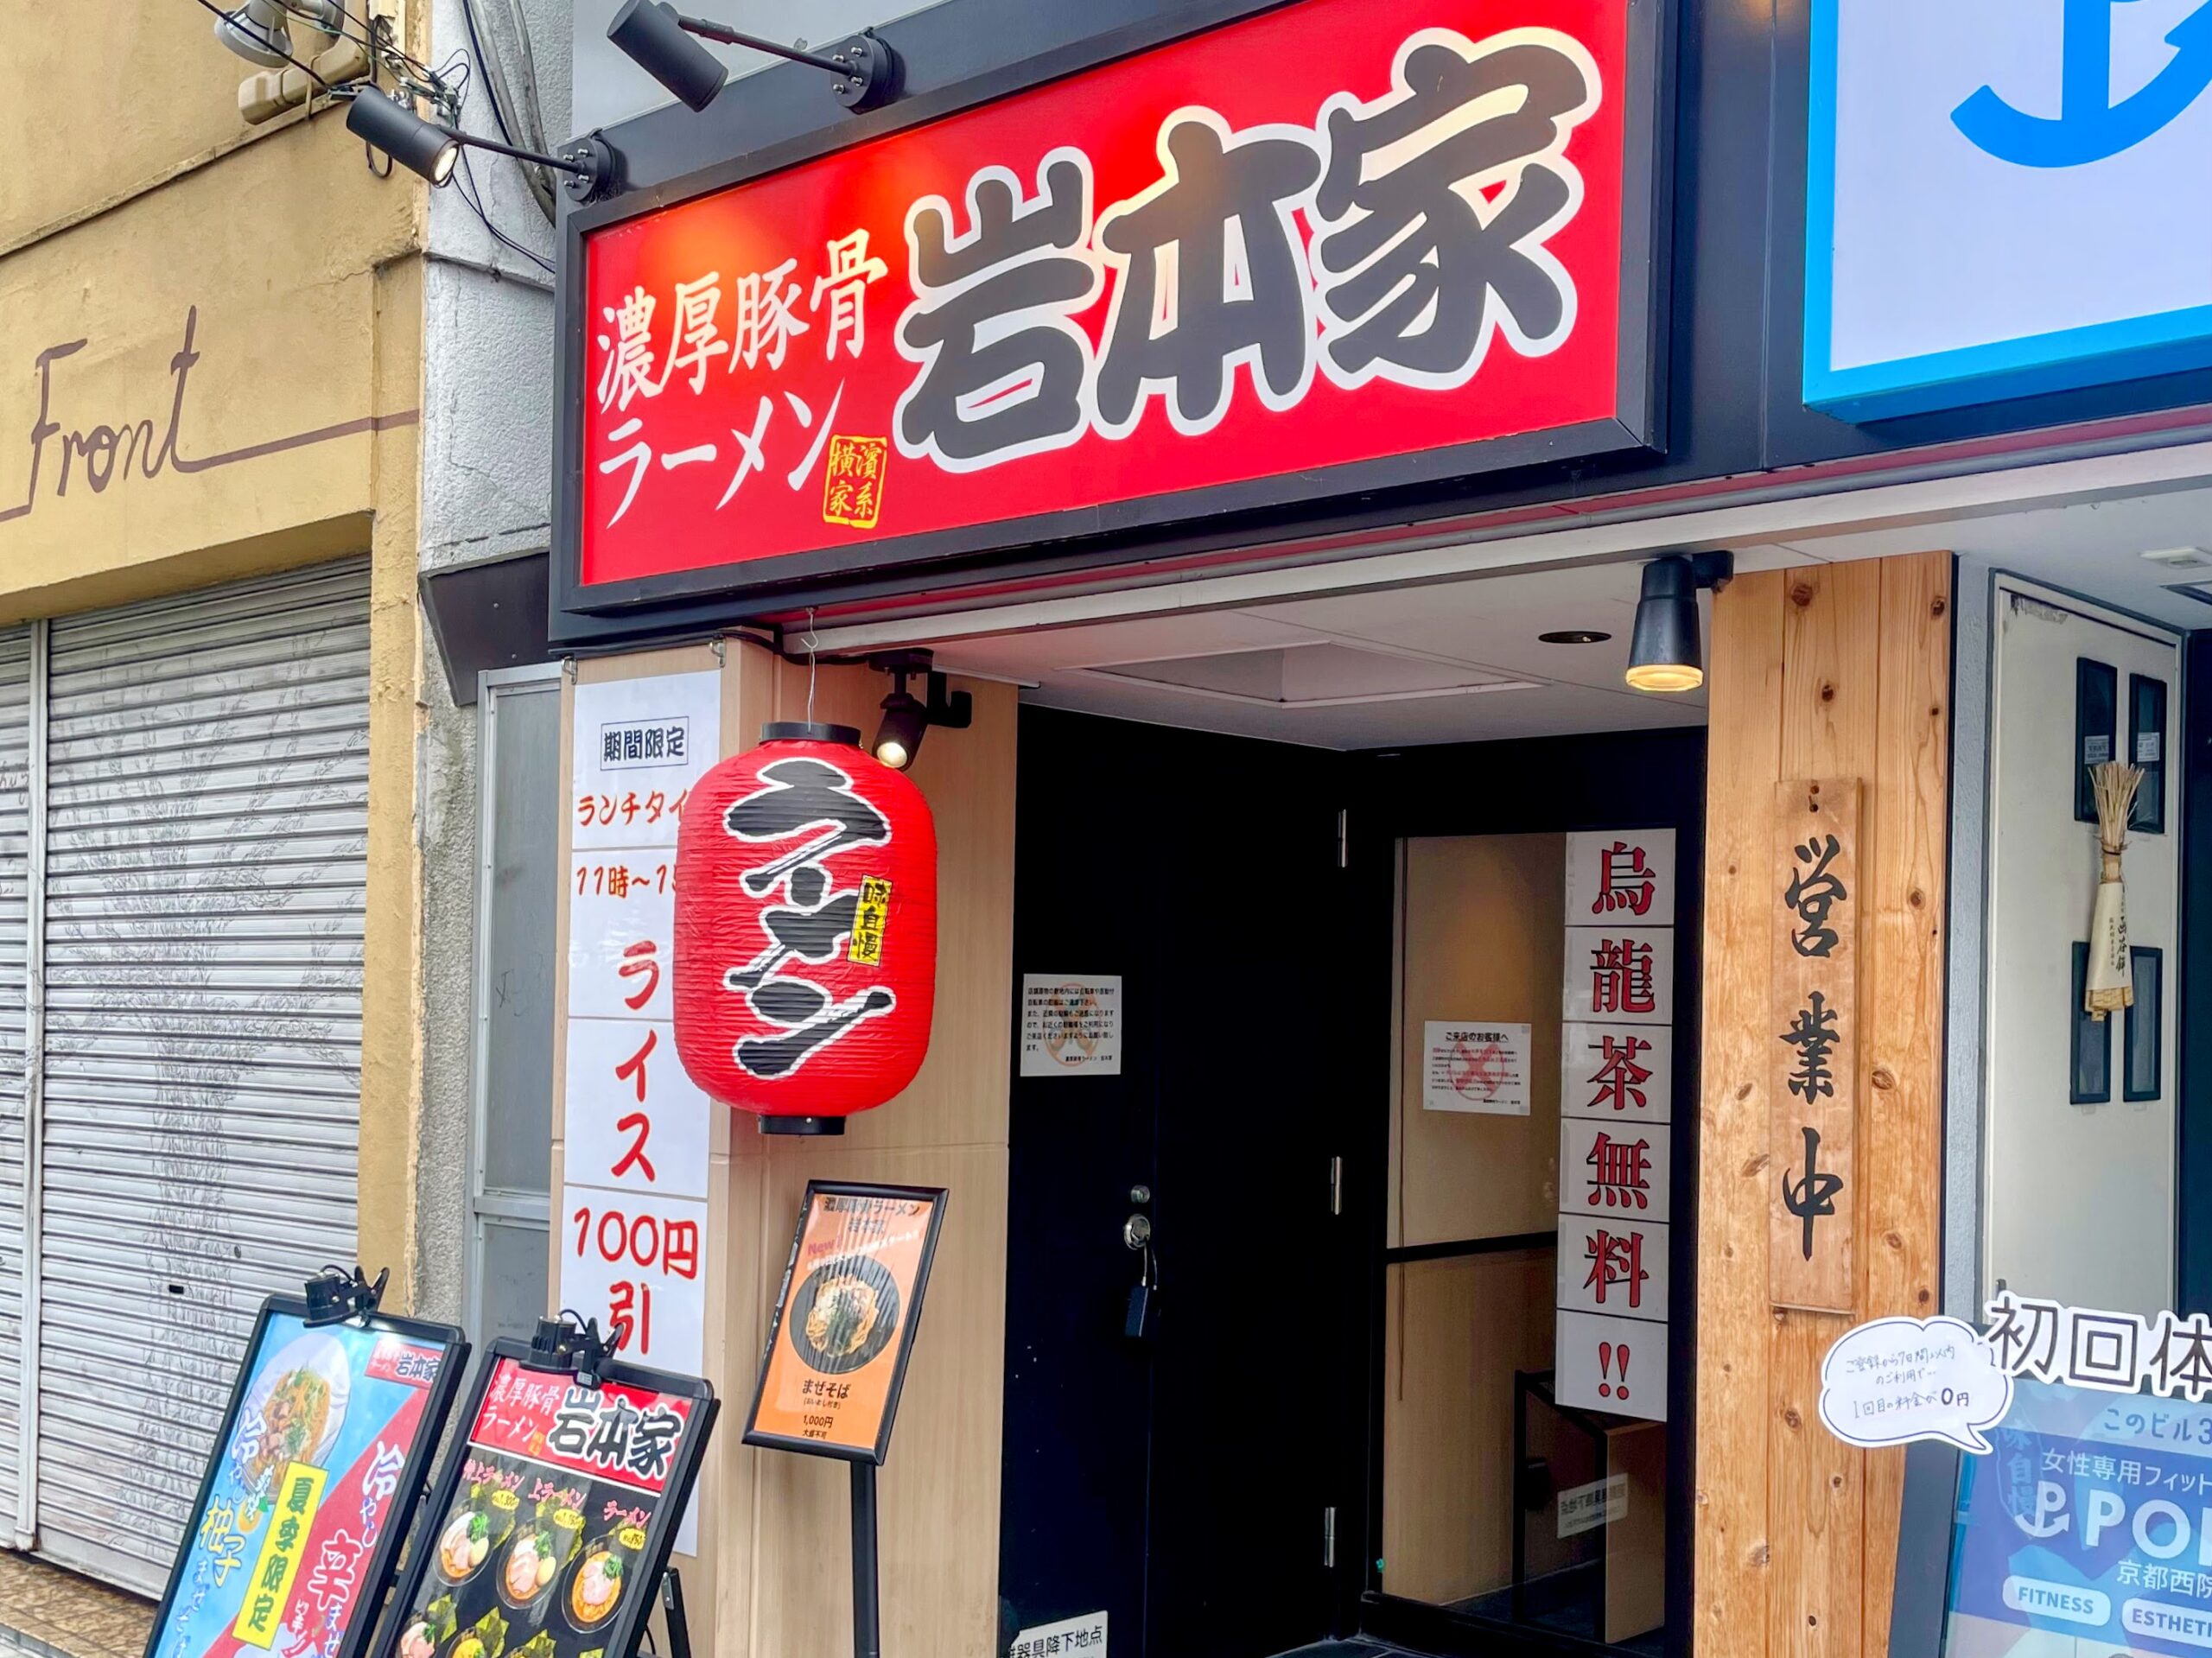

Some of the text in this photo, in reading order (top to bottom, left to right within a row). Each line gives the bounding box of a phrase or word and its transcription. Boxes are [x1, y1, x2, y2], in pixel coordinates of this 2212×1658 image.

[893, 28, 1602, 473] 岩本家
[597, 228, 888, 414] 濃厚豚骨
[29, 305, 200, 510] Front
[599, 378, 845, 530] ラーメン
[603, 726, 685, 762] 期間限定
[576, 864, 677, 899] 11時～1
[611, 938, 659, 1182] ライス
[1780, 834, 1847, 1261] 営業中
[1583, 841, 1656, 1401] 烏龍茶無料!!
[574, 1207, 698, 1280] 100円
[609, 1280, 650, 1356] 引
[483, 1406, 540, 1441] ラーメン
[490, 1374, 560, 1416] 濃厚豚骨
[802, 1379, 852, 1399] まぜそば
[803, 1414, 834, 1428] 1,000円
[546, 1386, 684, 1480] 岩本家
[247, 1477, 315, 1633] 夏季限定
[2018, 1586, 2094, 1615] FITNESS
